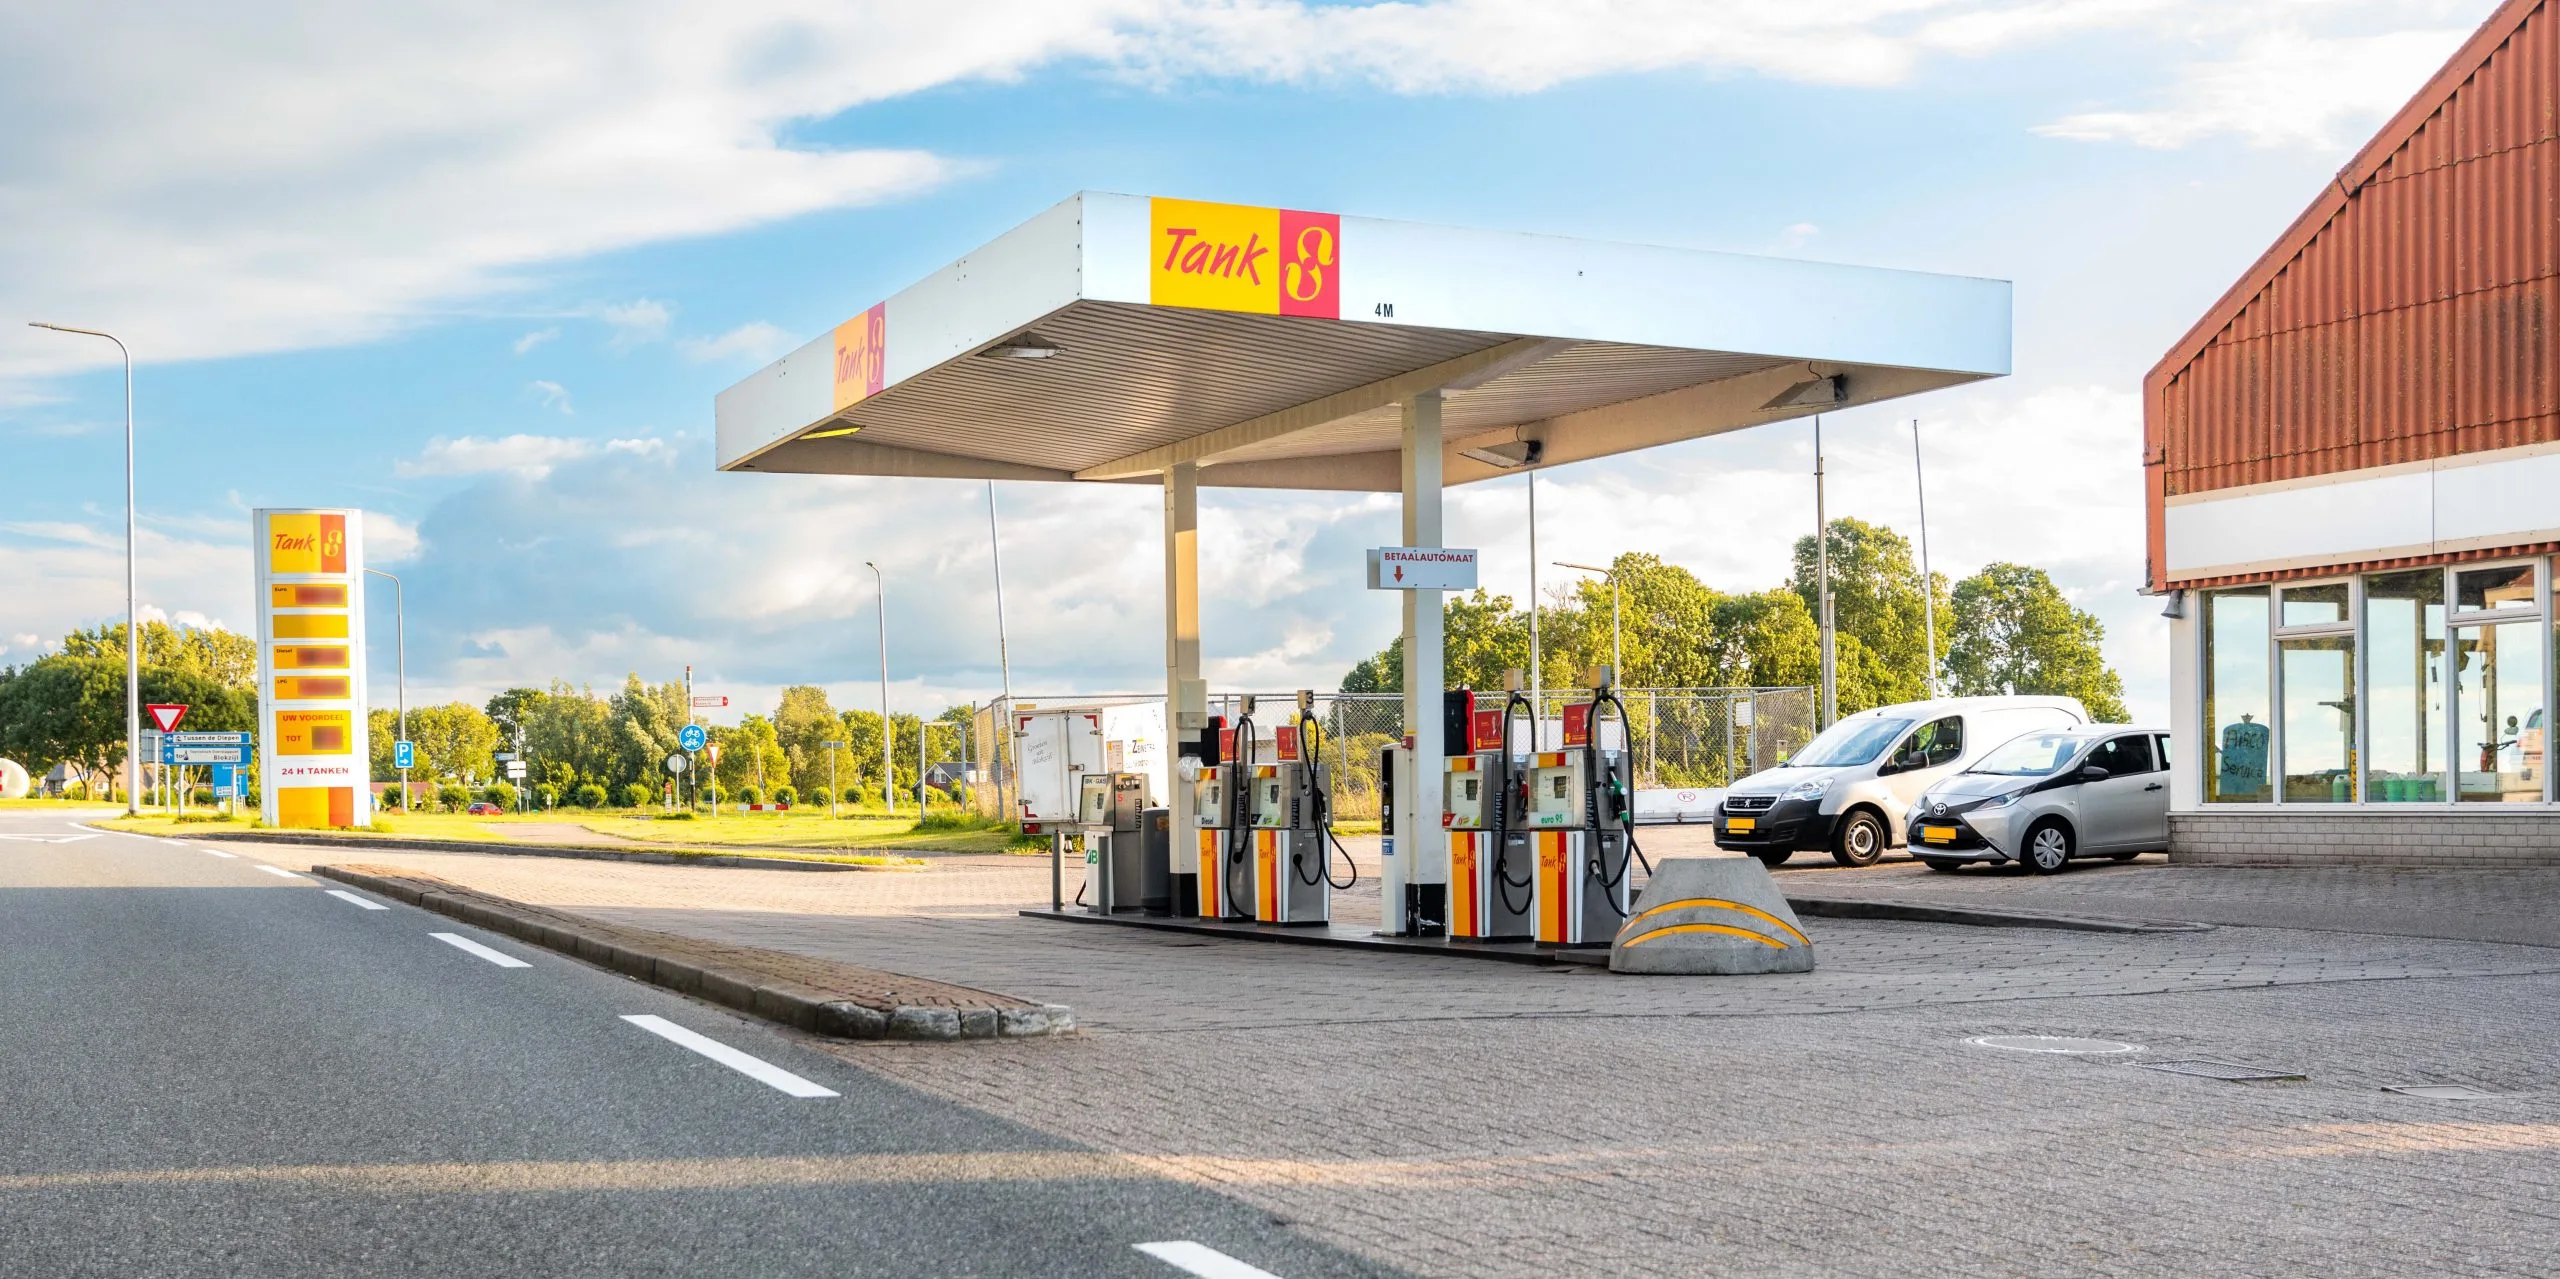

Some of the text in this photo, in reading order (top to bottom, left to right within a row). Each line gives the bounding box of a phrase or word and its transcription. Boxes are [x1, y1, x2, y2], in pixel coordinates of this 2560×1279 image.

[1163, 227, 1269, 287] Tank
[837, 335, 865, 385] Tank
[275, 533, 315, 552] Tank
[1384, 552, 1474, 563] BETAALAUTOMAAT
[1248, 697, 1255, 711] 4
[1305, 692, 1314, 704] 3
[399, 744, 409, 758] P
[281, 768, 294, 776] 24
[307, 767, 349, 775] TANKEN
[1201, 816, 1214, 825] Diesel
[1541, 813, 1563, 825] euro 95
[1453, 853, 1468, 867] Tank
[1541, 855, 1558, 869] Tank
